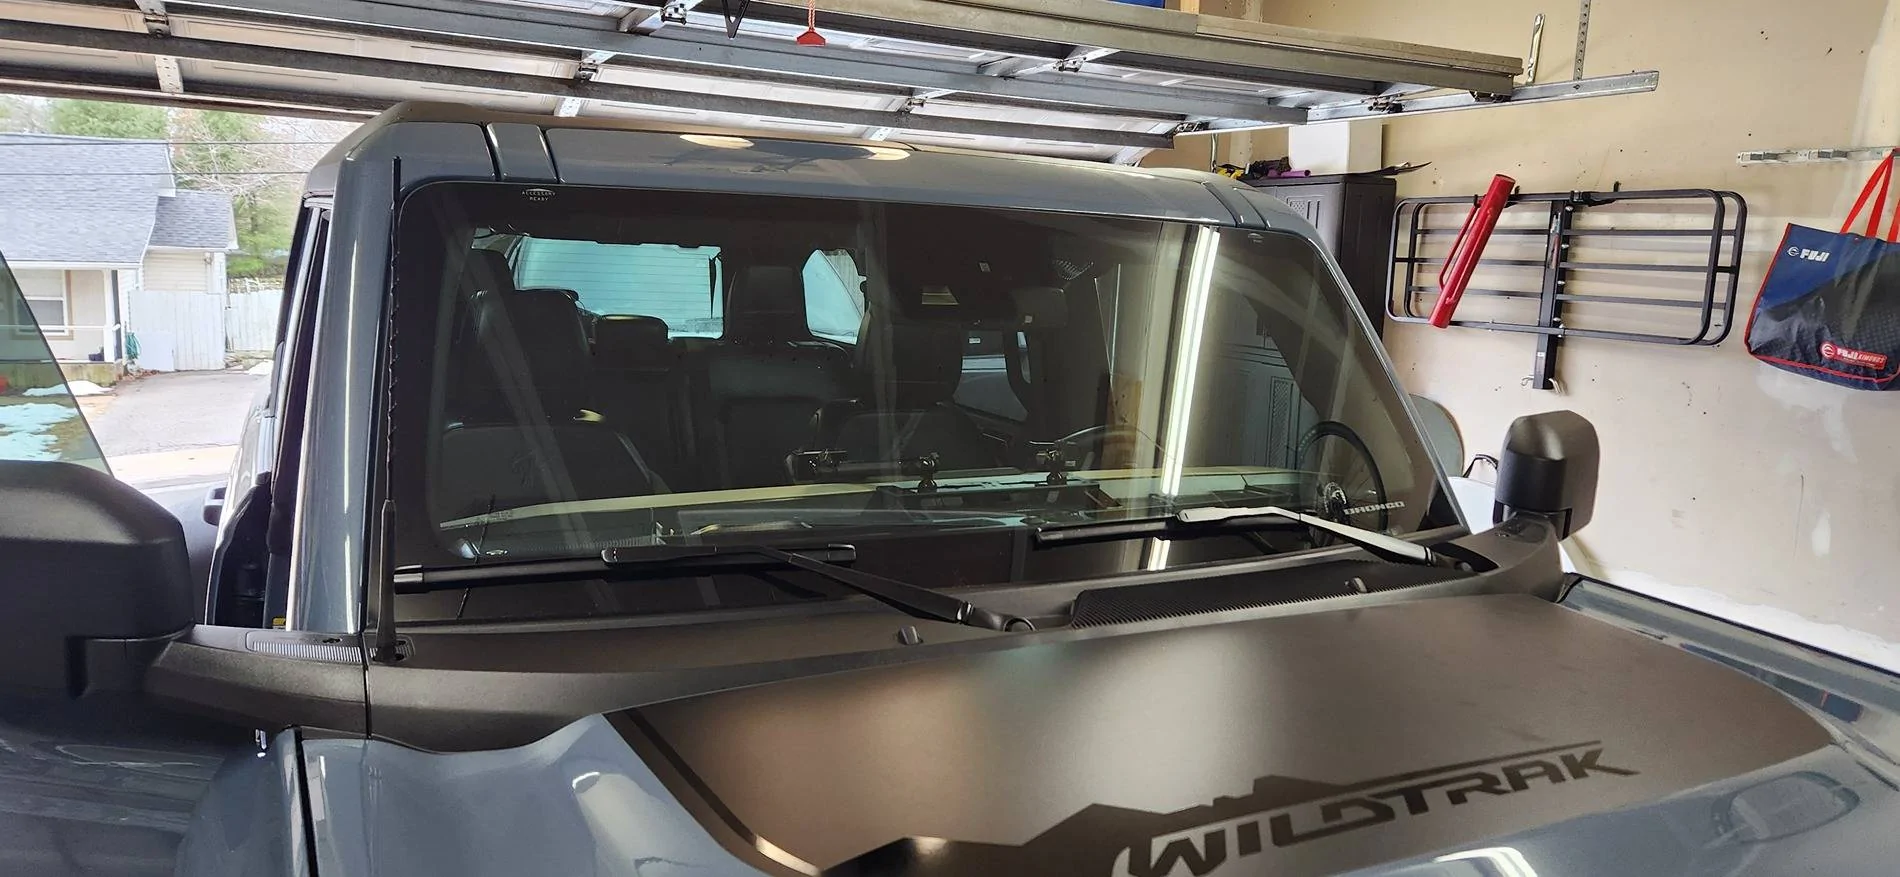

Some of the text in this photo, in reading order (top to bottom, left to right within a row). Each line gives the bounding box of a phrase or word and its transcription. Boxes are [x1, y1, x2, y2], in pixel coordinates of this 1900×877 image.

[1800, 248, 1830, 262] FUJI
[1837, 348, 1858, 359] FUJI
[1343, 501, 1405, 515] BRONCO
[1127, 748, 1640, 877] WILDTRAK
